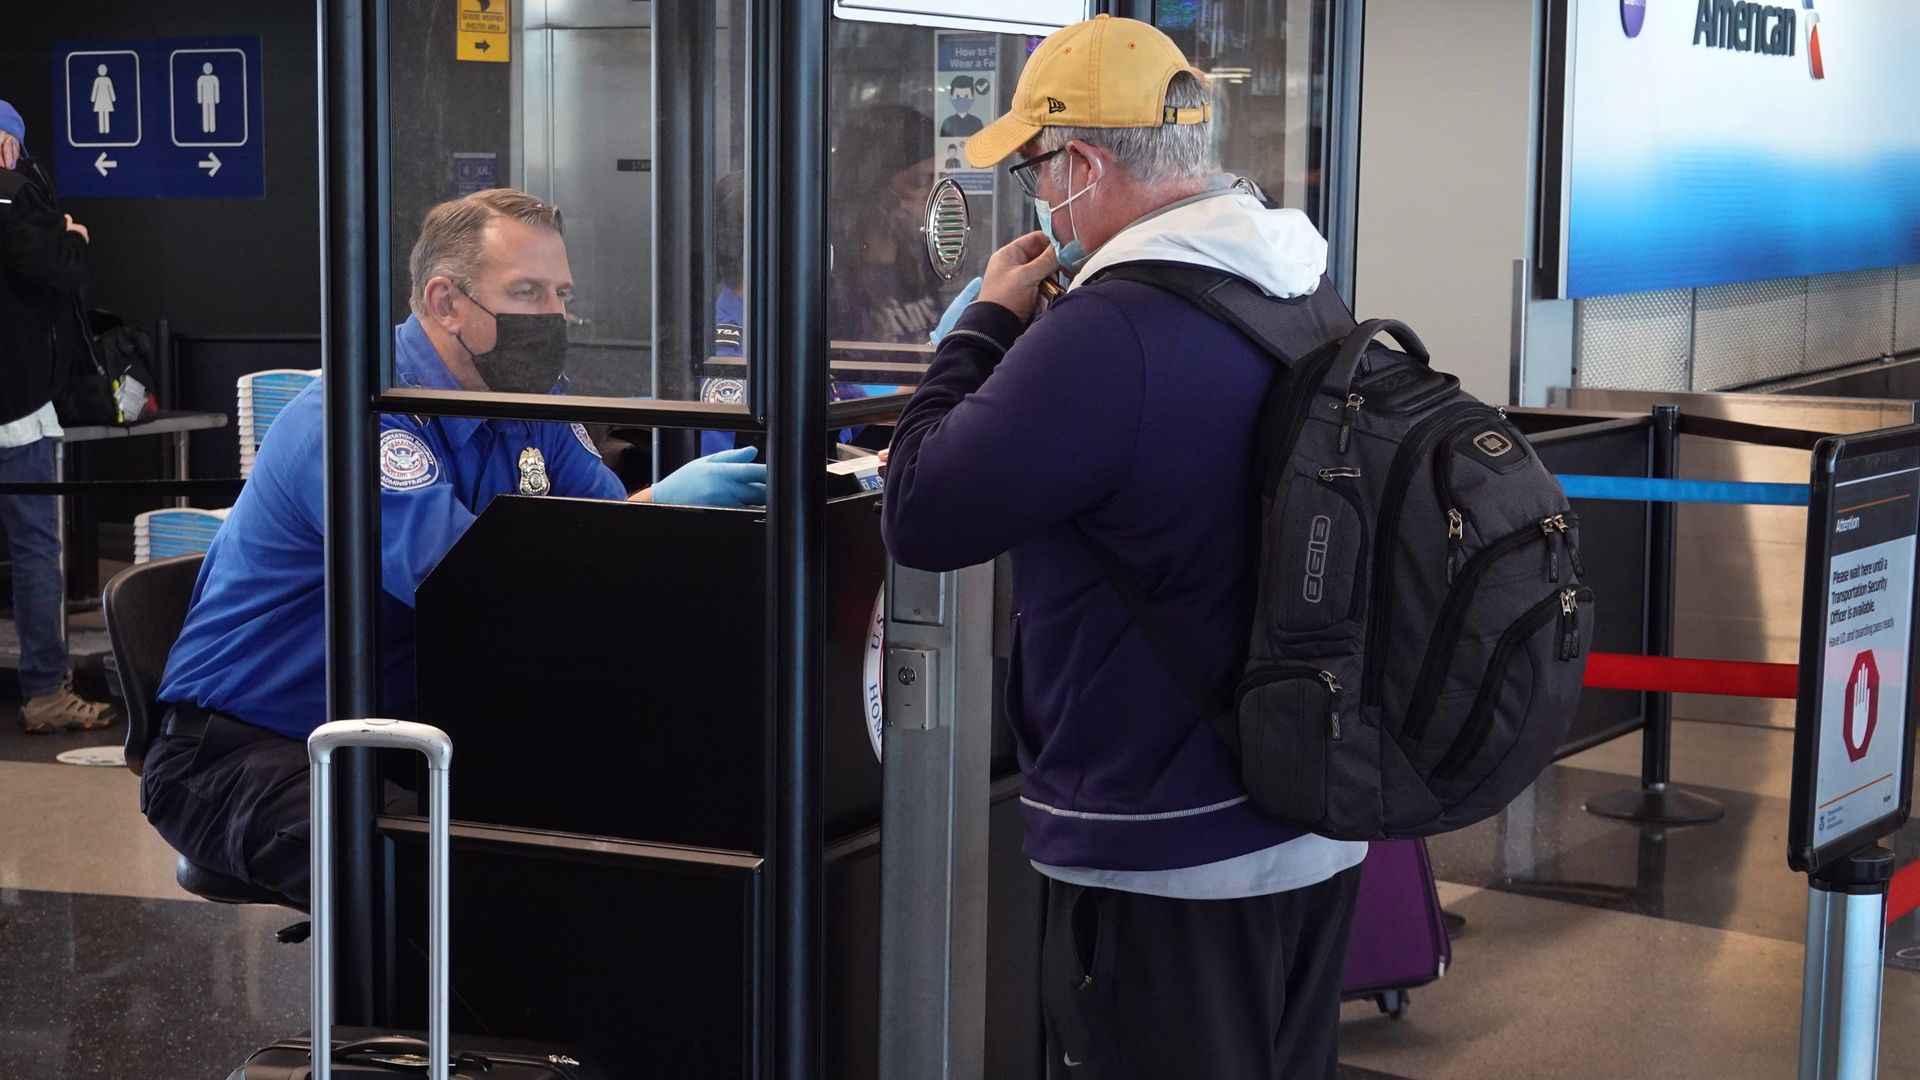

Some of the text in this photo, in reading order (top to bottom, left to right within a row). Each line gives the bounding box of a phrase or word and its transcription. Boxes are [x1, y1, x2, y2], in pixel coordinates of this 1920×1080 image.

[1693, 0, 1795, 57] American
[955, 48, 976, 57] How
[977, 47, 987, 57] to
[950, 58, 974, 68] Wear
[975, 60, 982, 68] a
[716, 328, 741, 337] TSA
[1836, 515, 1860, 534] Attention
[1303, 514, 1331, 603] OGIO
[1832, 569, 1849, 585] Please
[1849, 563, 1861, 580] wait
[1861, 562, 1872, 577] here
[1872, 557, 1884, 573] until
[1831, 576, 1888, 604] Transportation Security
[1830, 608, 1847, 625] Officer
[1847, 606, 1852, 619] is
